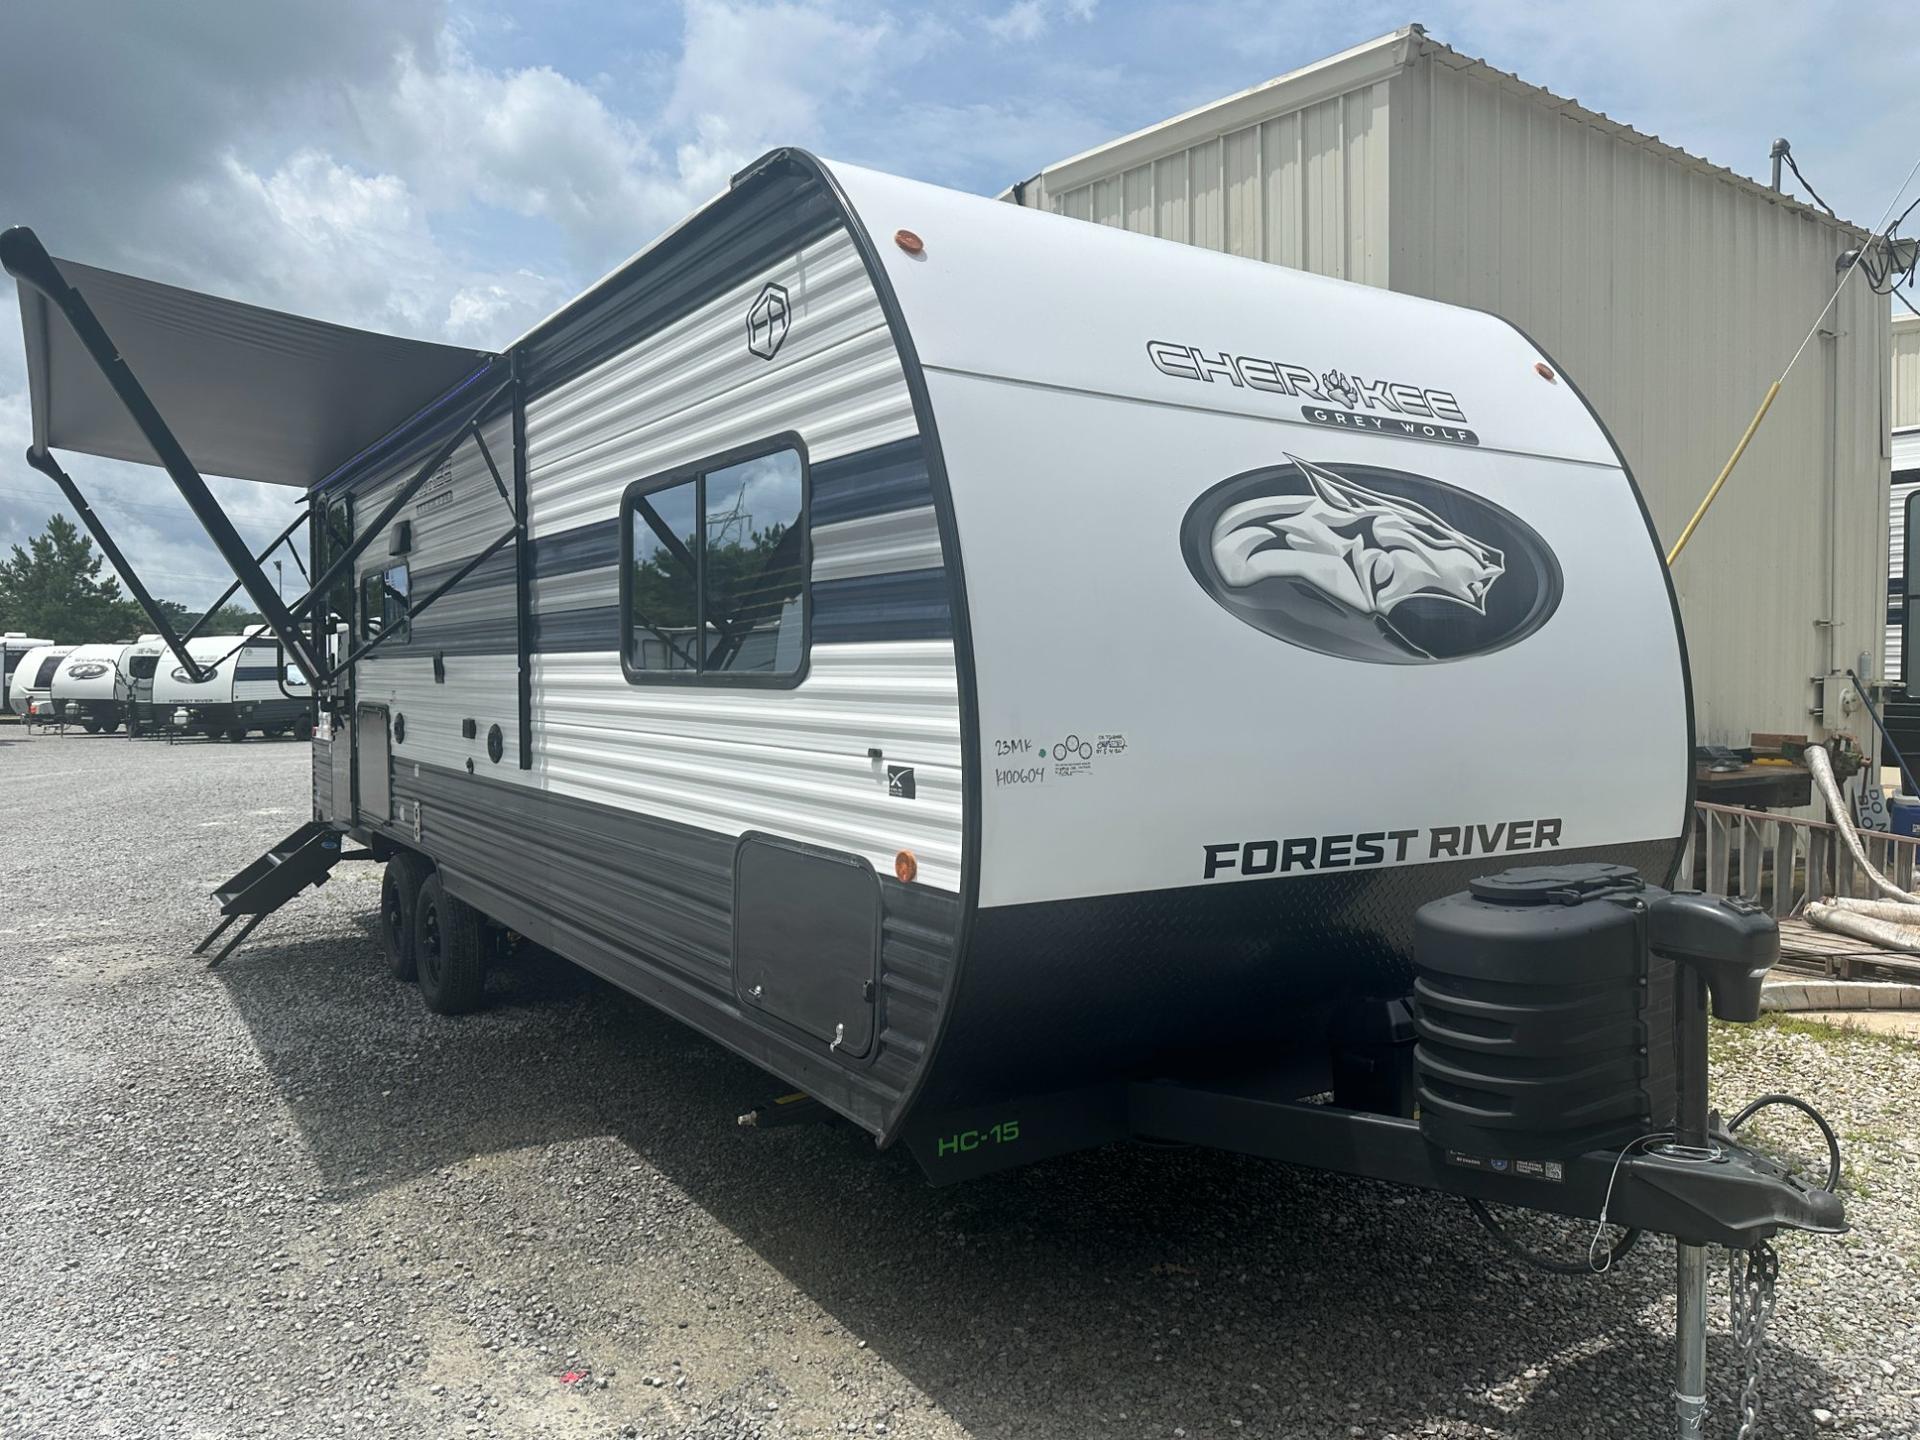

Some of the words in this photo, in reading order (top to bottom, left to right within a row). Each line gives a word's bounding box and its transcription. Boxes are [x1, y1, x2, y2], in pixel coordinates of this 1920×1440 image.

[1313, 409, 1383, 430] GREY
[1400, 421, 1468, 441] WOLF
[1868, 788, 1883, 814] DO
[1203, 829, 1419, 880] FOREST
[1428, 818, 1563, 858] RIVER
[938, 1120, 1020, 1157] HC-15
